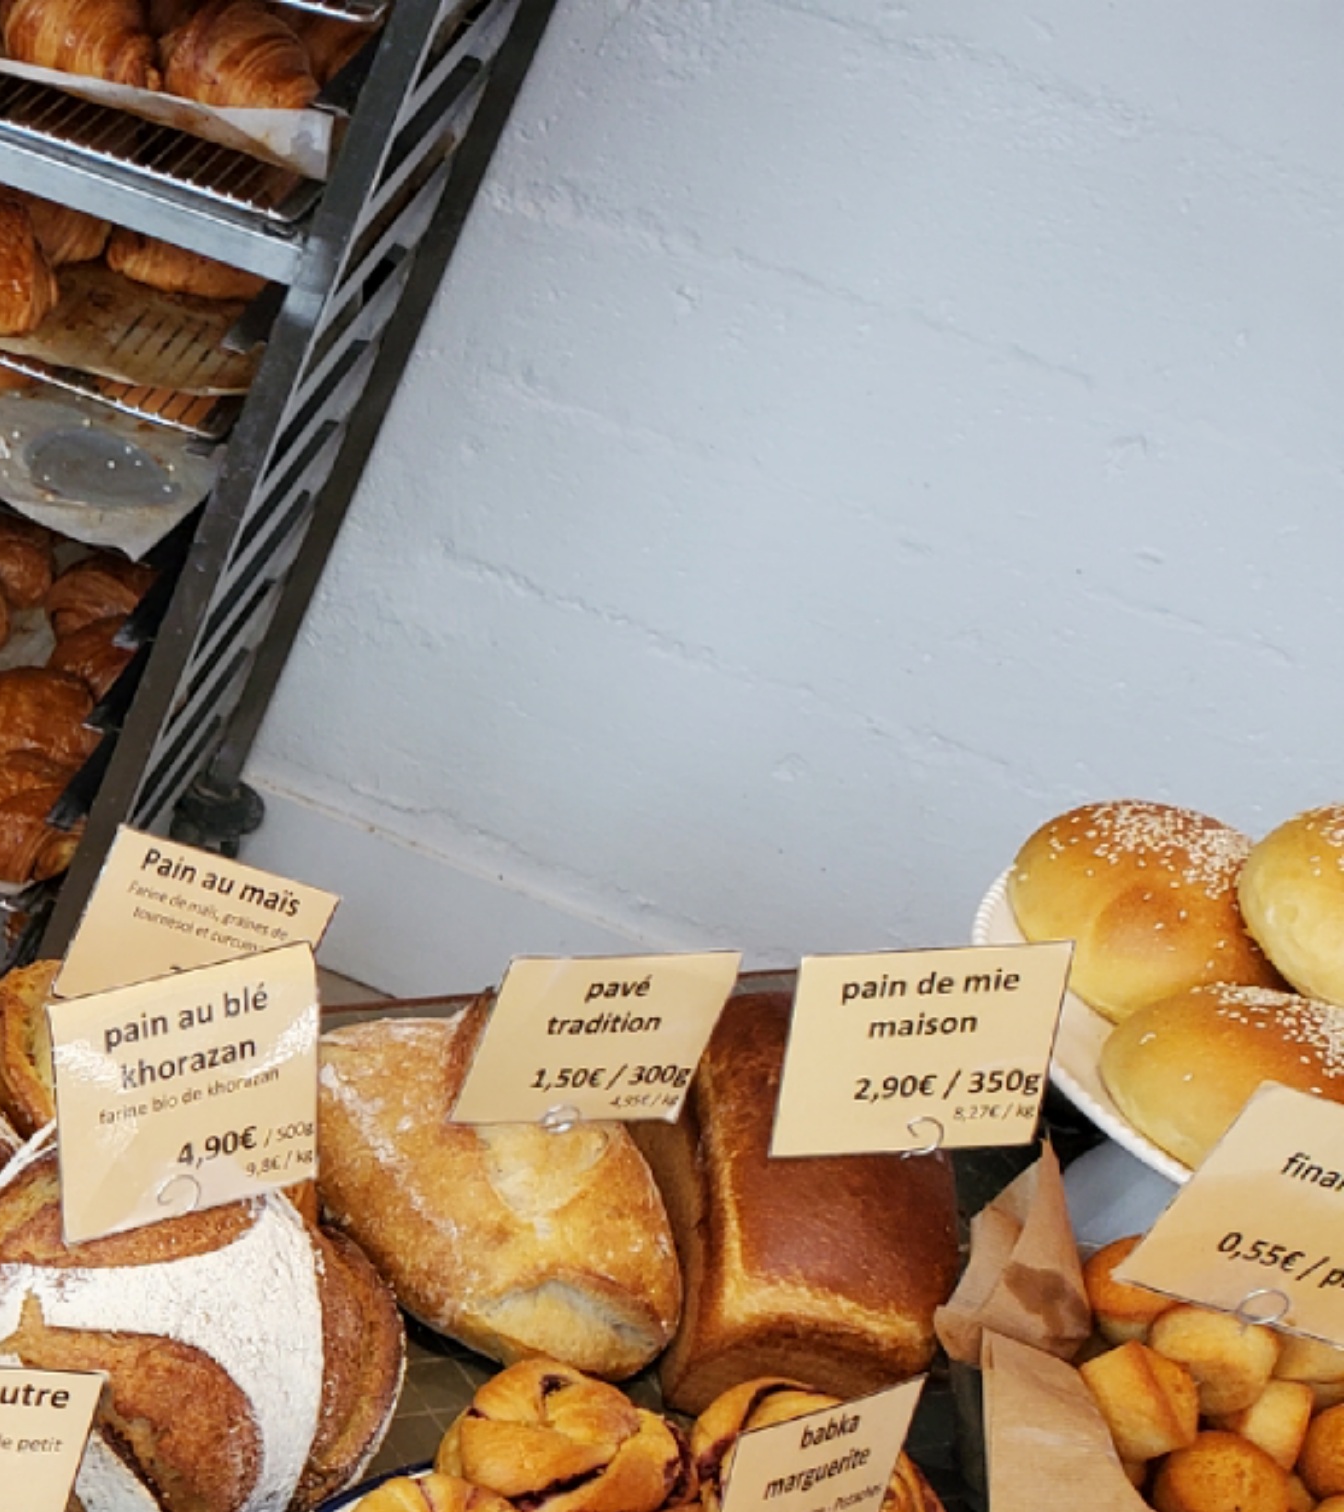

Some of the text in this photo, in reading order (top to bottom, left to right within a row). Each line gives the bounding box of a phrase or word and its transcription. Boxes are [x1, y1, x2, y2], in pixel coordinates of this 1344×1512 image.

[140, 849, 300, 917] Pain au maïs
[585, 974, 653, 1003] pavé
[842, 969, 1020, 1005] pain de mie
[104, 982, 268, 1054] pain au blé
[547, 1012, 661, 1035] tradition
[868, 1013, 978, 1039] maison
[121, 1038, 256, 1089] khorazan
[530, 1064, 691, 1093] 1,50€ 300g
[854, 1069, 1042, 1103] 2,90€ 350g
[99, 1099, 148, 1125] farine
[152, 1094, 177, 1110] bio
[182, 1088, 202, 1103] de
[177, 1125, 258, 1170] 4,90€
[1217, 1232, 1305, 1273] 0,55€
[17, 1436, 63, 1452] petit
[799, 1413, 861, 1450] babka
[763, 1447, 871, 1500] marguerite
